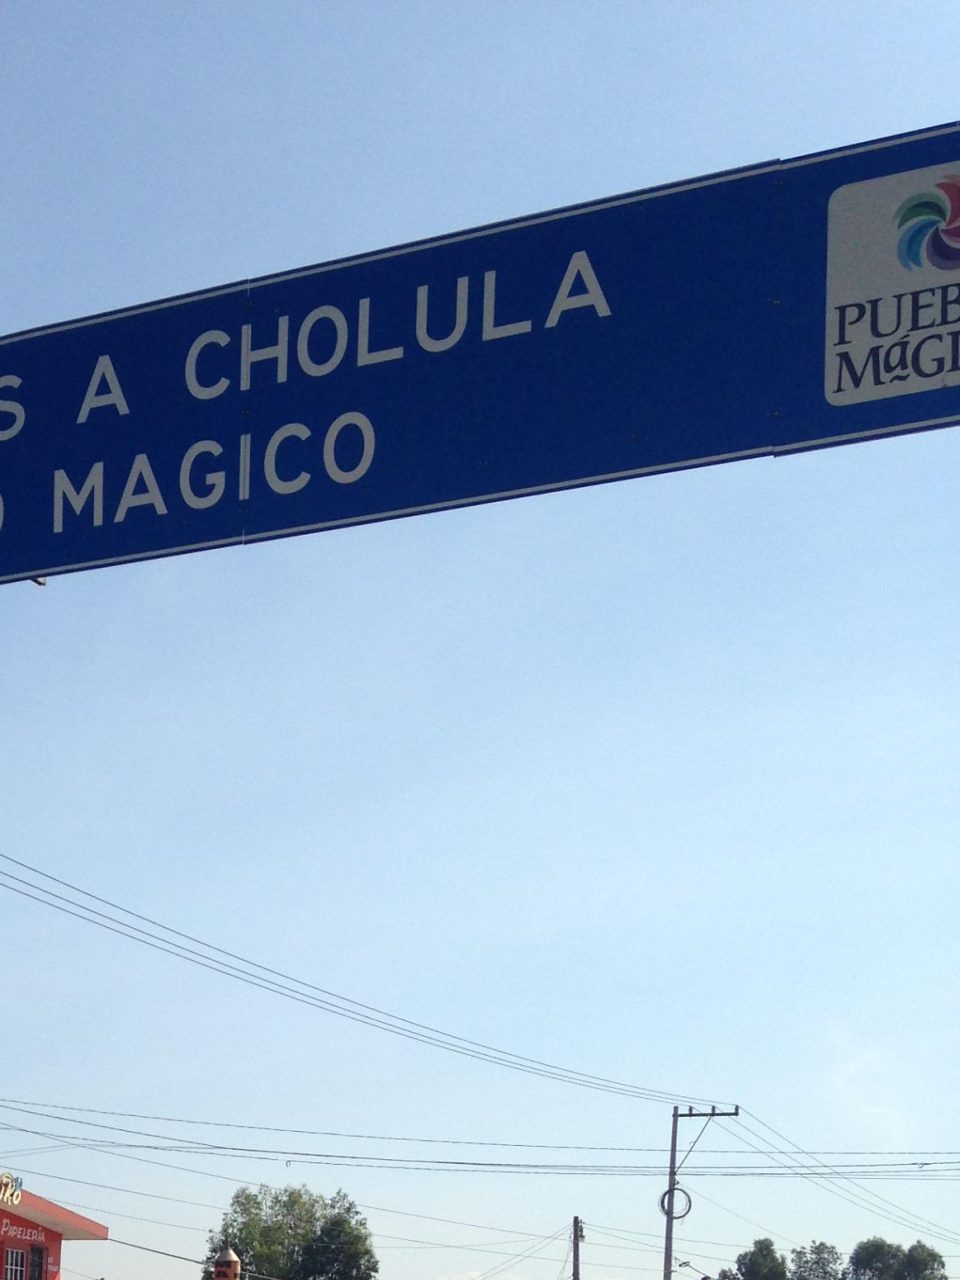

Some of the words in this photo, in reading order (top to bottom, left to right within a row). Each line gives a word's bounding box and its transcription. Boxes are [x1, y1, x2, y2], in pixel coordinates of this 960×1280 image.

[77, 355, 130, 424] A
[185, 250, 611, 400] CHOLULA
[53, 411, 375, 533] MAGICO
